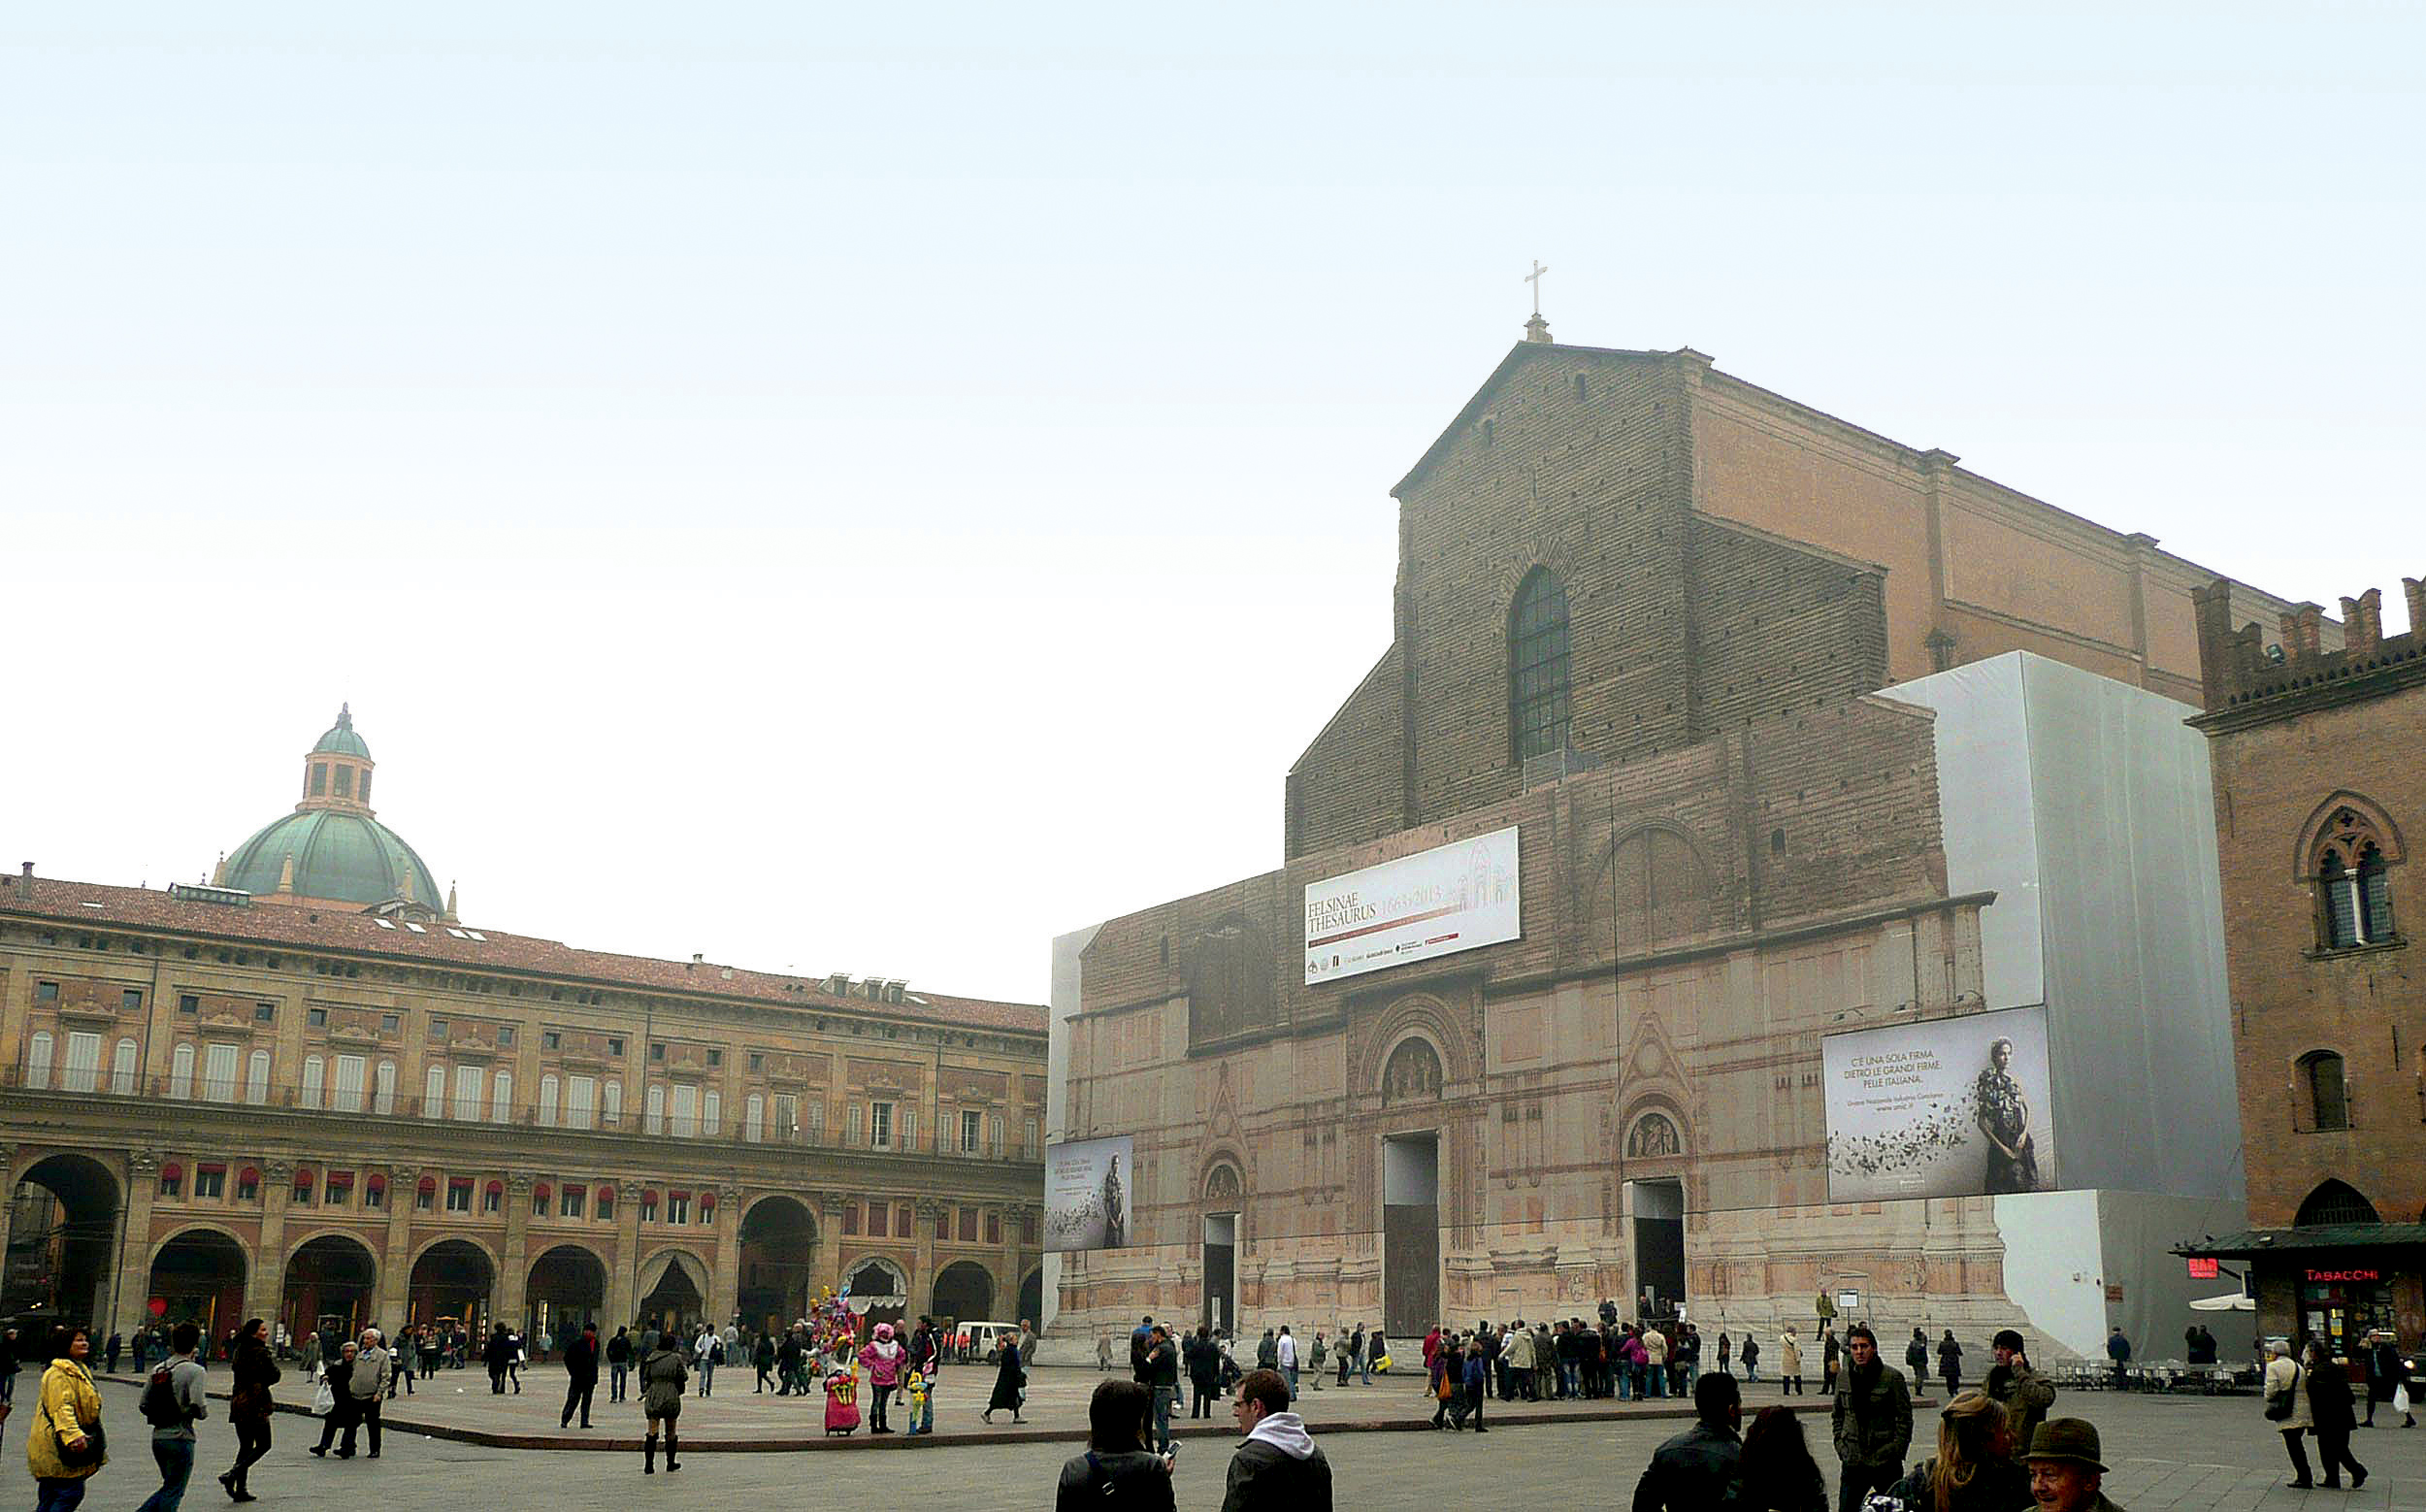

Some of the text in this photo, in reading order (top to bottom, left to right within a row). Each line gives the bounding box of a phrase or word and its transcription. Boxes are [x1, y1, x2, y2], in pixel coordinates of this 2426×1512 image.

[1308, 892, 1359, 917] FELSINAE
[1308, 903, 1376, 933] THESAURUS
[1865, 1055, 1885, 1066] UNA
[1885, 1052, 1907, 1064] SOLA
[1909, 1049, 1934, 1061] FIRMA
[1844, 1068, 1871, 1079] DIETRO
[1873, 1067, 1883, 1076] LE
[1883, 1063, 1916, 1075] GRANDI
[2304, 1269, 2379, 1281] TABACCHI
